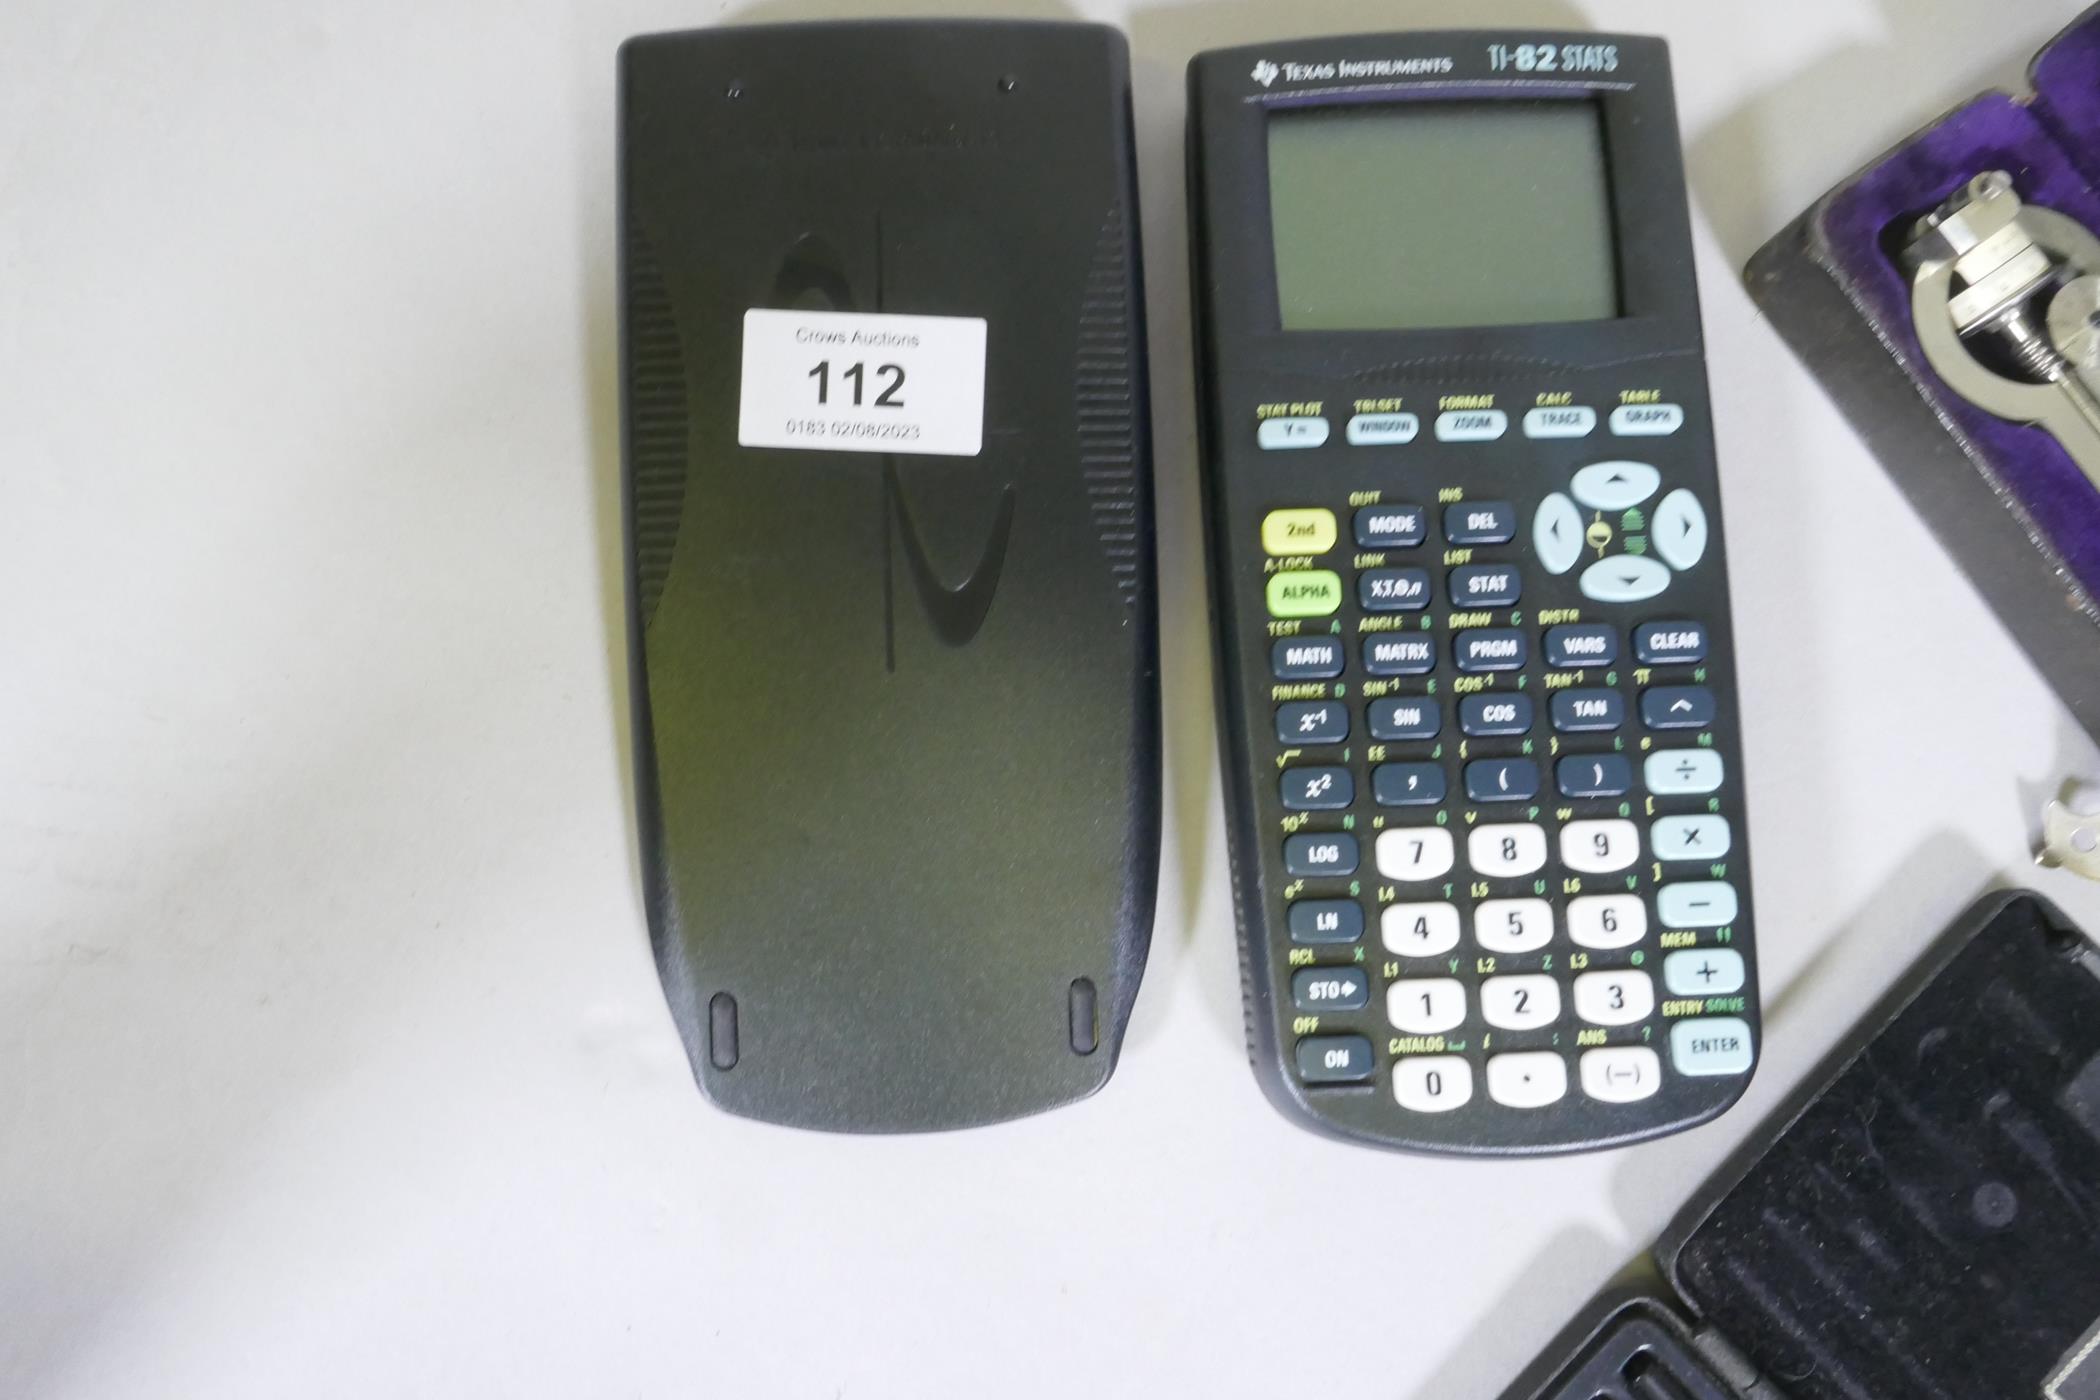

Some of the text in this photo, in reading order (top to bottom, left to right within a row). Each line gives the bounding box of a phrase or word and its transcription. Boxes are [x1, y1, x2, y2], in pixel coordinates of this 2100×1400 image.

[1488, 43, 1618, 72] TI-82 STATS
[796, 326, 919, 348] Crows Auctions
[808, 361, 906, 408] 112
[1257, 401, 1323, 419] STAT PLOT
[786, 419, 920, 440] 0183 02/08/2023
[1358, 419, 1411, 433] WINDOW
[1349, 490, 1381, 507] QUIT
[1287, 522, 1316, 538] 2nd
[1369, 515, 1416, 534] MODE
[1468, 512, 1498, 531] DEL
[1444, 549, 1472, 565] LIST
[1282, 584, 1331, 600] ALPHA
[1469, 574, 1509, 593] STAT
[1267, 620, 1301, 636] TEST
[1359, 616, 1403, 632] ANGLE
[1449, 612, 1492, 628] DRAW
[1470, 639, 1518, 658] PRGM
[1563, 636, 1607, 655] VARS
[1650, 631, 1699, 650] CLEAR
[1286, 646, 1333, 666] MATH
[1375, 643, 1429, 662] MATRX
[1272, 683, 1326, 700] FINANCE
[1393, 708, 1421, 726] SIN
[1482, 704, 1516, 722] COS
[1573, 700, 1608, 717] TAN
[1308, 844, 1339, 864] LOG
[1409, 840, 1424, 865] 7
[1501, 836, 1517, 861] 8
[1593, 832, 1609, 857] 9
[1316, 911, 1338, 931] LN
[1413, 915, 1430, 940] 4
[1508, 912, 1523, 936] 5
[1602, 908, 1617, 933] 6
[1660, 932, 1697, 948] MEM
[1289, 948, 1316, 966] RCL
[1477, 957, 1496, 974] L2
[1570, 952, 1588, 969] L3
[1384, 961, 1399, 979] L1
[1421, 993, 1432, 1017] 1
[1514, 989, 1530, 1014] 2
[1607, 985, 1624, 1010] 3
[1662, 1000, 1704, 1017] ENTRY
[1293, 1016, 1319, 1035] OFF
[1389, 1036, 1445, 1054] CATALOG
[1577, 1029, 1607, 1046] ANS
[1691, 1037, 1739, 1054] ENTER
[1325, 1050, 1349, 1068] ON
[1426, 1071, 1441, 1096] 0
